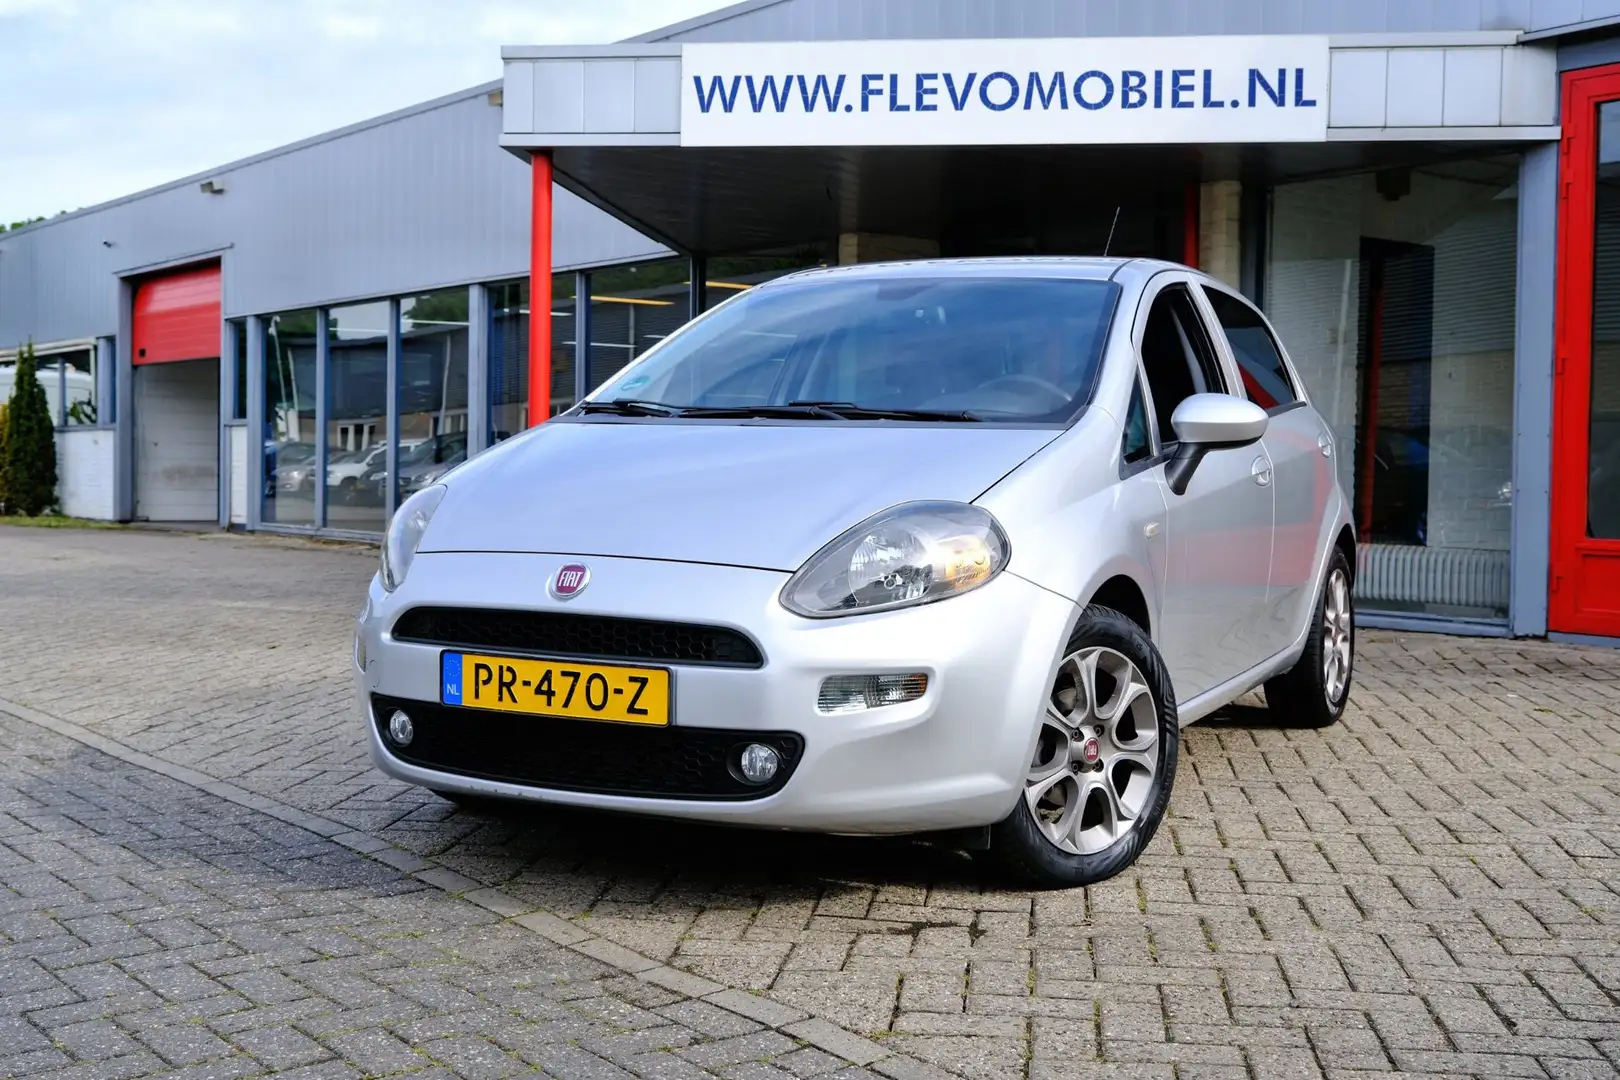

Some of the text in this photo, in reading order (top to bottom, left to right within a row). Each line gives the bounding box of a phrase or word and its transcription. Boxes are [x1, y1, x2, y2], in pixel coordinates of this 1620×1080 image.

[693, 68, 1317, 113] WWW.FLEVOMOBIEL.NL
[558, 570, 583, 588] FIAT
[446, 683, 460, 696] NL
[474, 662, 649, 715] PR-470-Z
